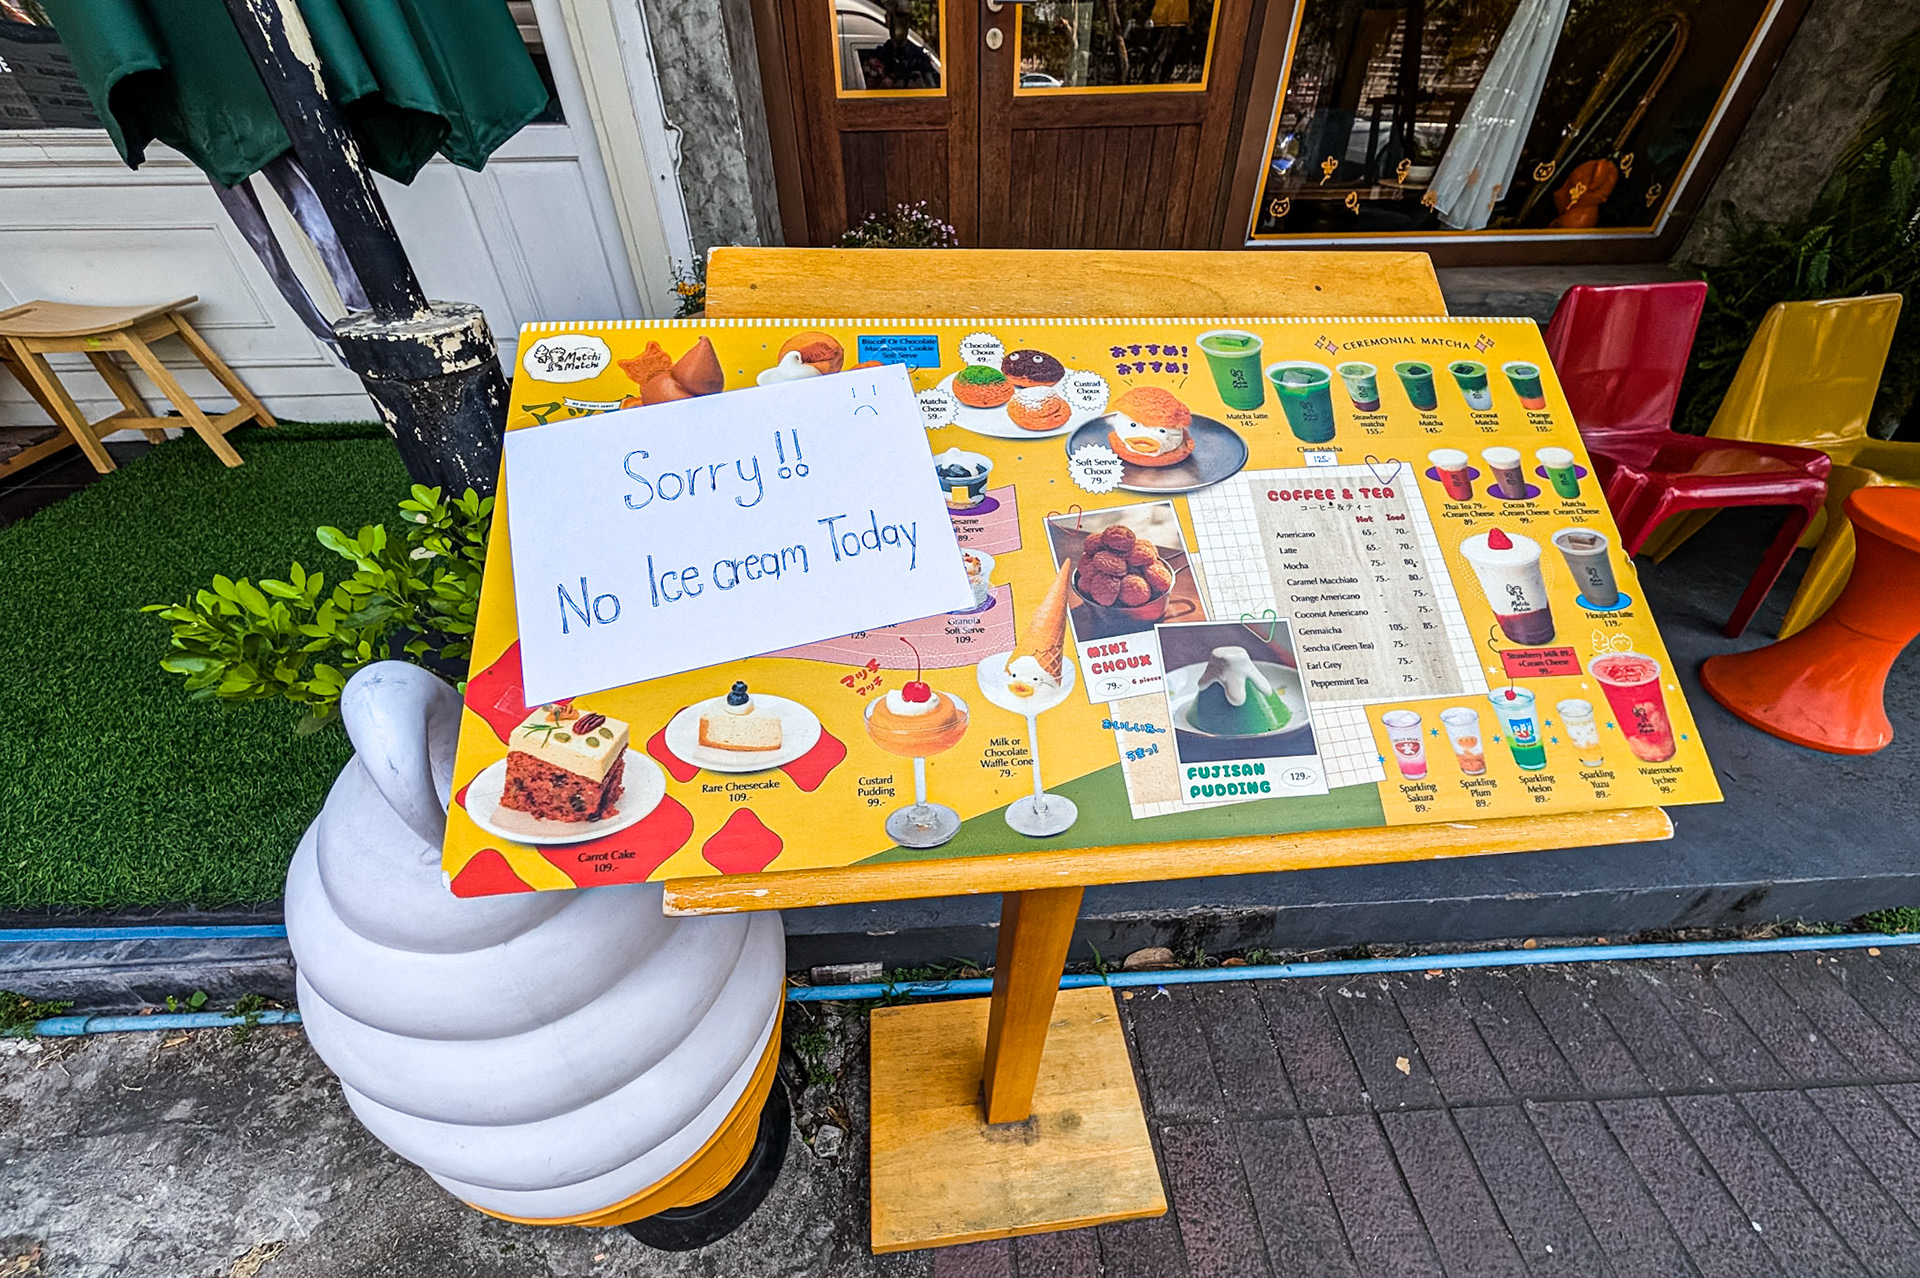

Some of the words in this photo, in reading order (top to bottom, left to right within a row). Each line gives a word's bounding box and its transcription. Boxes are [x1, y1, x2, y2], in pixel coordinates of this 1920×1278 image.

[1342, 337, 1416, 351] CEREMONIAL
[1421, 337, 1470, 350] MATCHA
[565, 352, 601, 362] Matchi
[564, 362, 599, 371] Matchi
[1352, 413, 1388, 421] Strawberry
[1527, 412, 1551, 420] Orange
[1268, 488, 1336, 502] COFFEE
[1342, 488, 1353, 500] &
[1359, 487, 1394, 499] TEA
[556, 577, 621, 634] No
[646, 554, 704, 607] Ice
[712, 544, 809, 591] cream
[818, 509, 917, 571] Today
[1287, 578, 1318, 586] Caramel
[1291, 595, 1319, 603] Orange
[1586, 612, 1617, 620] Houjicha
[945, 626, 960, 634] Soft
[962, 626, 985, 634] Serve
[1299, 627, 1342, 635] Genmaicha
[955, 636, 977, 644] 109.-
[1087, 641, 1128, 659] MINI
[1331, 643, 1357, 651] (Green
[1359, 642, 1374, 650] Tea)
[1506, 652, 1542, 660] Strawberry
[1092, 654, 1152, 675] CHOUX
[1307, 662, 1321, 670] Earl
[1323, 662, 1342, 670] Grey
[840, 658, 881, 689] マッチ
[856, 676, 883, 697] マッチ
[1106, 683, 1122, 691] 79.-
[1139, 676, 1161, 685] pieces
[1311, 678, 1354, 689] Peppermint
[990, 738, 1009, 746] Milk
[984, 748, 1028, 757] Chocolate
[980, 759, 1008, 768] Waffle
[1010, 758, 1034, 766] Cone
[1000, 770, 1017, 778] 79.-
[1187, 762, 1266, 780] FUJISAN
[1638, 766, 1683, 775] Watermelon
[1290, 772, 1311, 781] 129.-
[1519, 775, 1556, 784] Sparkling
[1579, 771, 1616, 780] Sparkling
[859, 775, 893, 786] Custard
[1460, 778, 1497, 788] Sparkling
[1652, 776, 1677, 785] Lychee
[702, 782, 723, 793] Rare
[725, 780, 780, 792] Cheesecake
[1190, 781, 1271, 798] PUDDING
[1400, 784, 1437, 793] Sparkling
[1527, 785, 1552, 793] Melon
[858, 787, 895, 798] Pudding
[1471, 789, 1491, 797] Plum
[729, 793, 753, 802] 109.-
[1407, 794, 1434, 802] Sakura
[868, 799, 886, 807] 99.-
[578, 852, 609, 864] Carrot
[612, 850, 636, 860] Cake
[593, 863, 619, 874] 109.-
